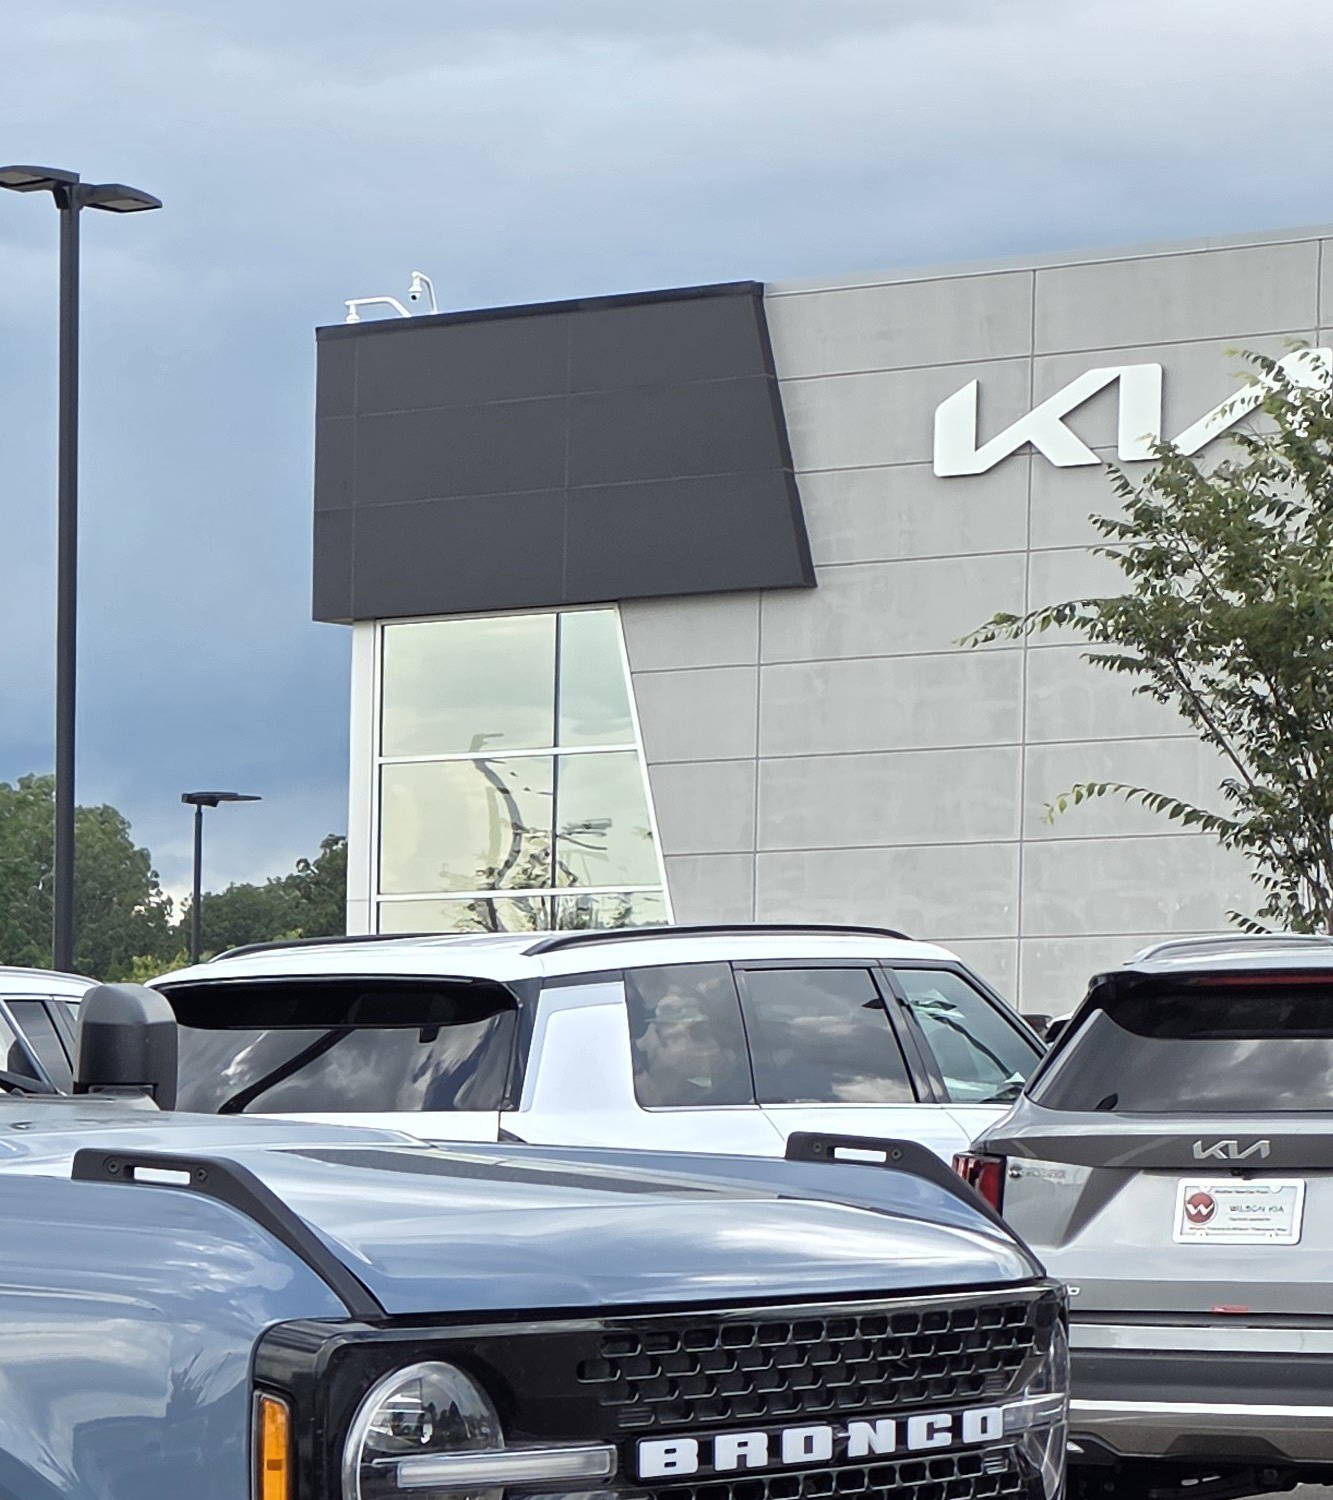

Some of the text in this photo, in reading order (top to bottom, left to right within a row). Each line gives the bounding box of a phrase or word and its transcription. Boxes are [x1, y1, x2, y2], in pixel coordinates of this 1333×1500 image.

[933, 347, 1332, 477] KIA
[1192, 1139, 1271, 1160] KIA
[1229, 1204, 1266, 1213] WILSON
[638, 1406, 1004, 1479] BRONCO
